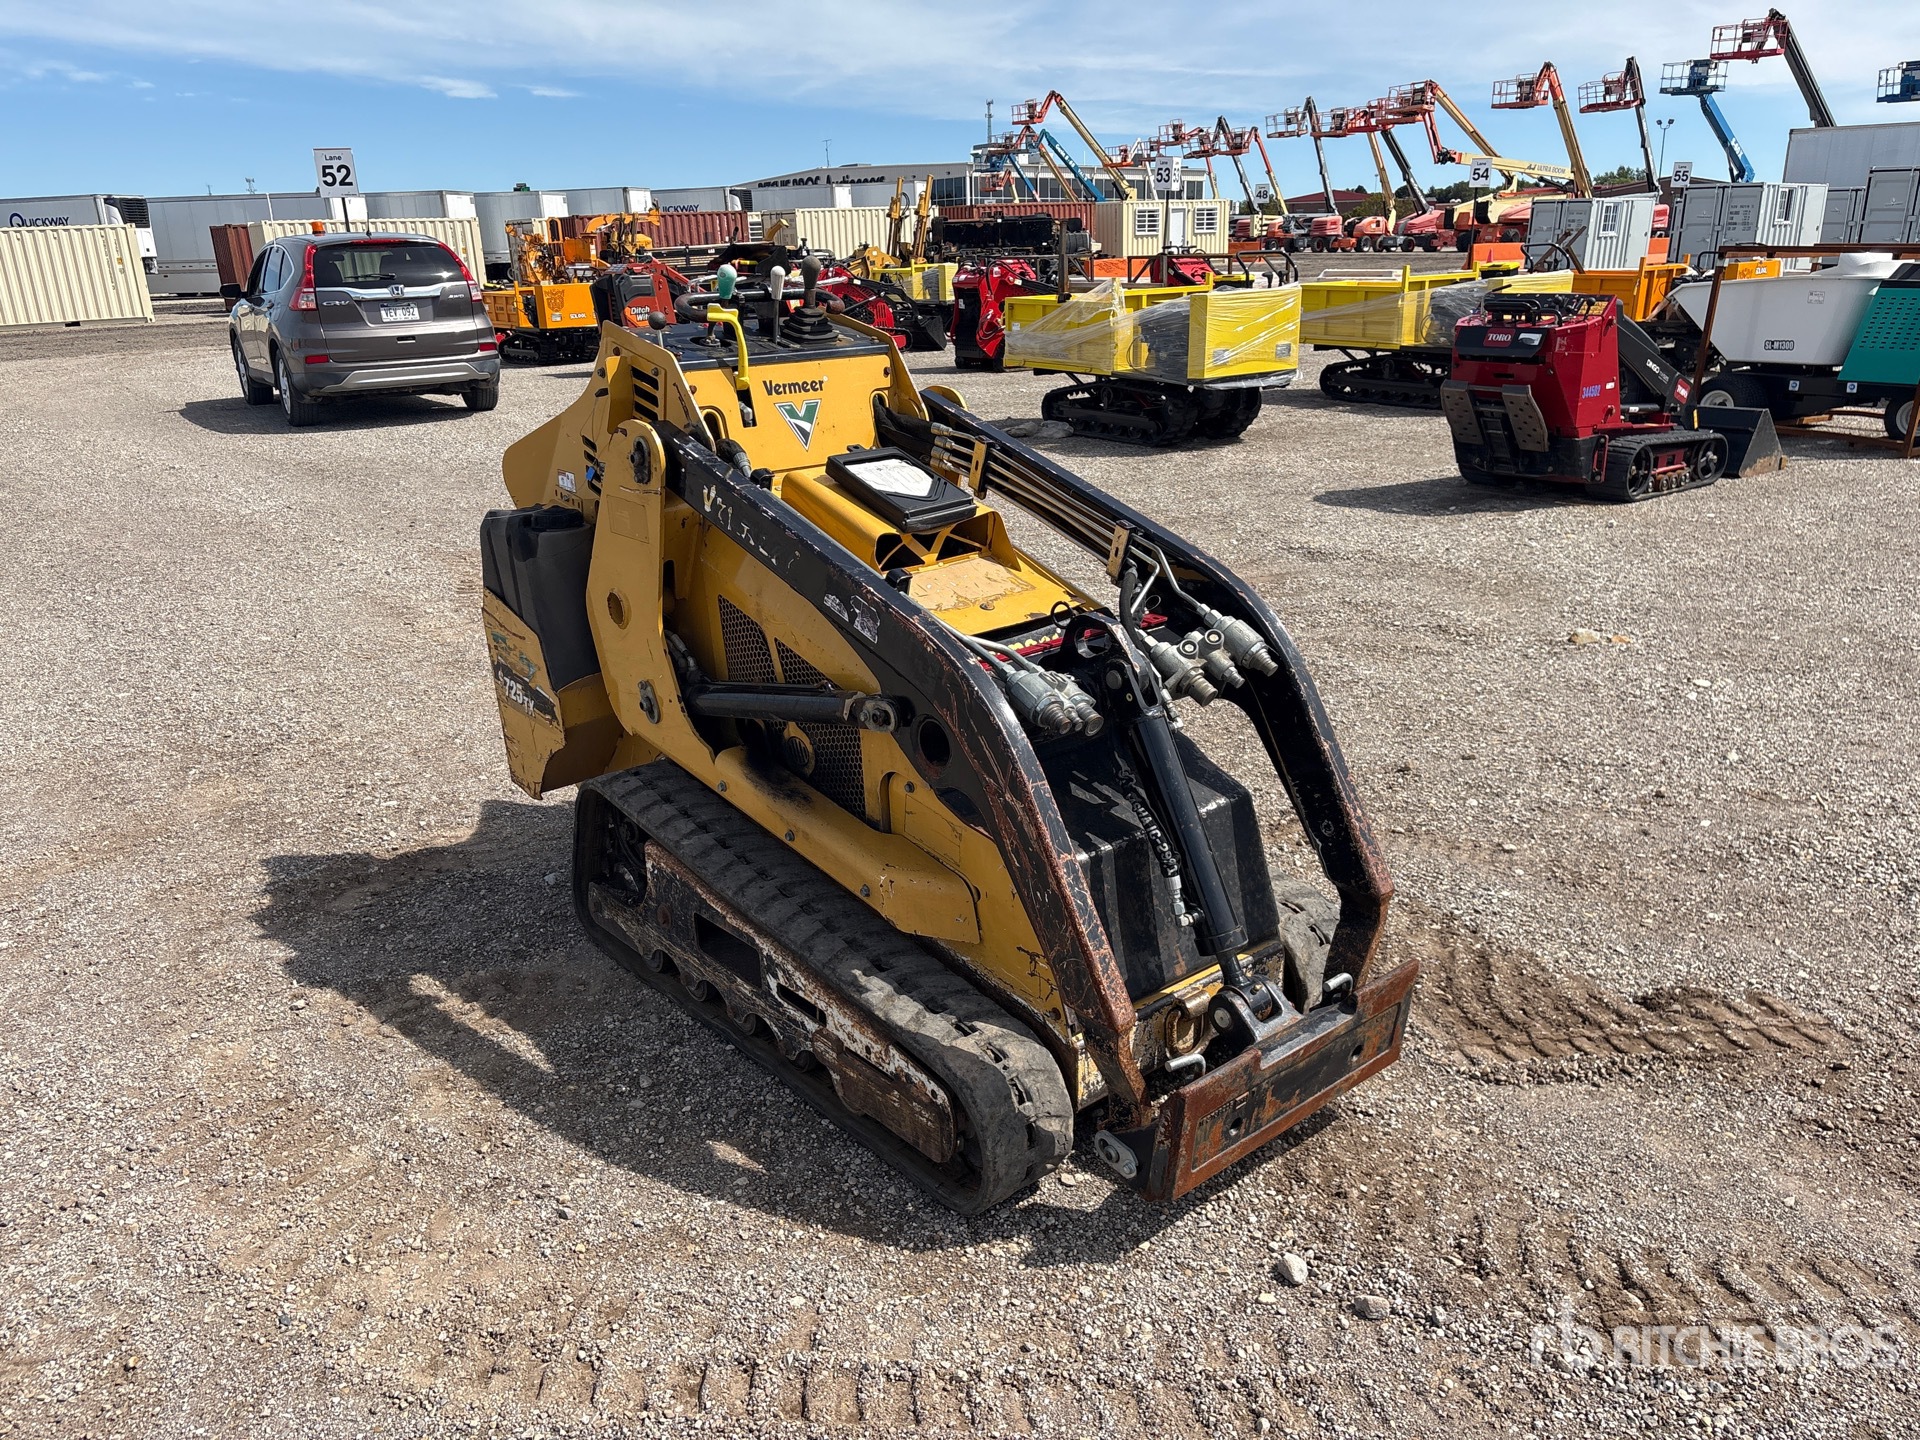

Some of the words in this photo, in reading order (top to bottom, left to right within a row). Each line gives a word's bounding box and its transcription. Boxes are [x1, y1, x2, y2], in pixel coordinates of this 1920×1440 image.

[321, 164, 354, 187] 52
[1156, 167, 1171, 183] 53
[1472, 167, 1490, 181] 54
[1673, 170, 1690, 182] 55
[1255, 190, 1268, 199] 48
[401, 306, 416, 317] 092
[630, 306, 650, 315] Ditch
[636, 313, 650, 321] Wit
[1487, 333, 1512, 342] TORO
[1764, 340, 1795, 350] SL-M1300
[762, 380, 824, 396] Vermeer
[1581, 384, 1601, 399] 344502
